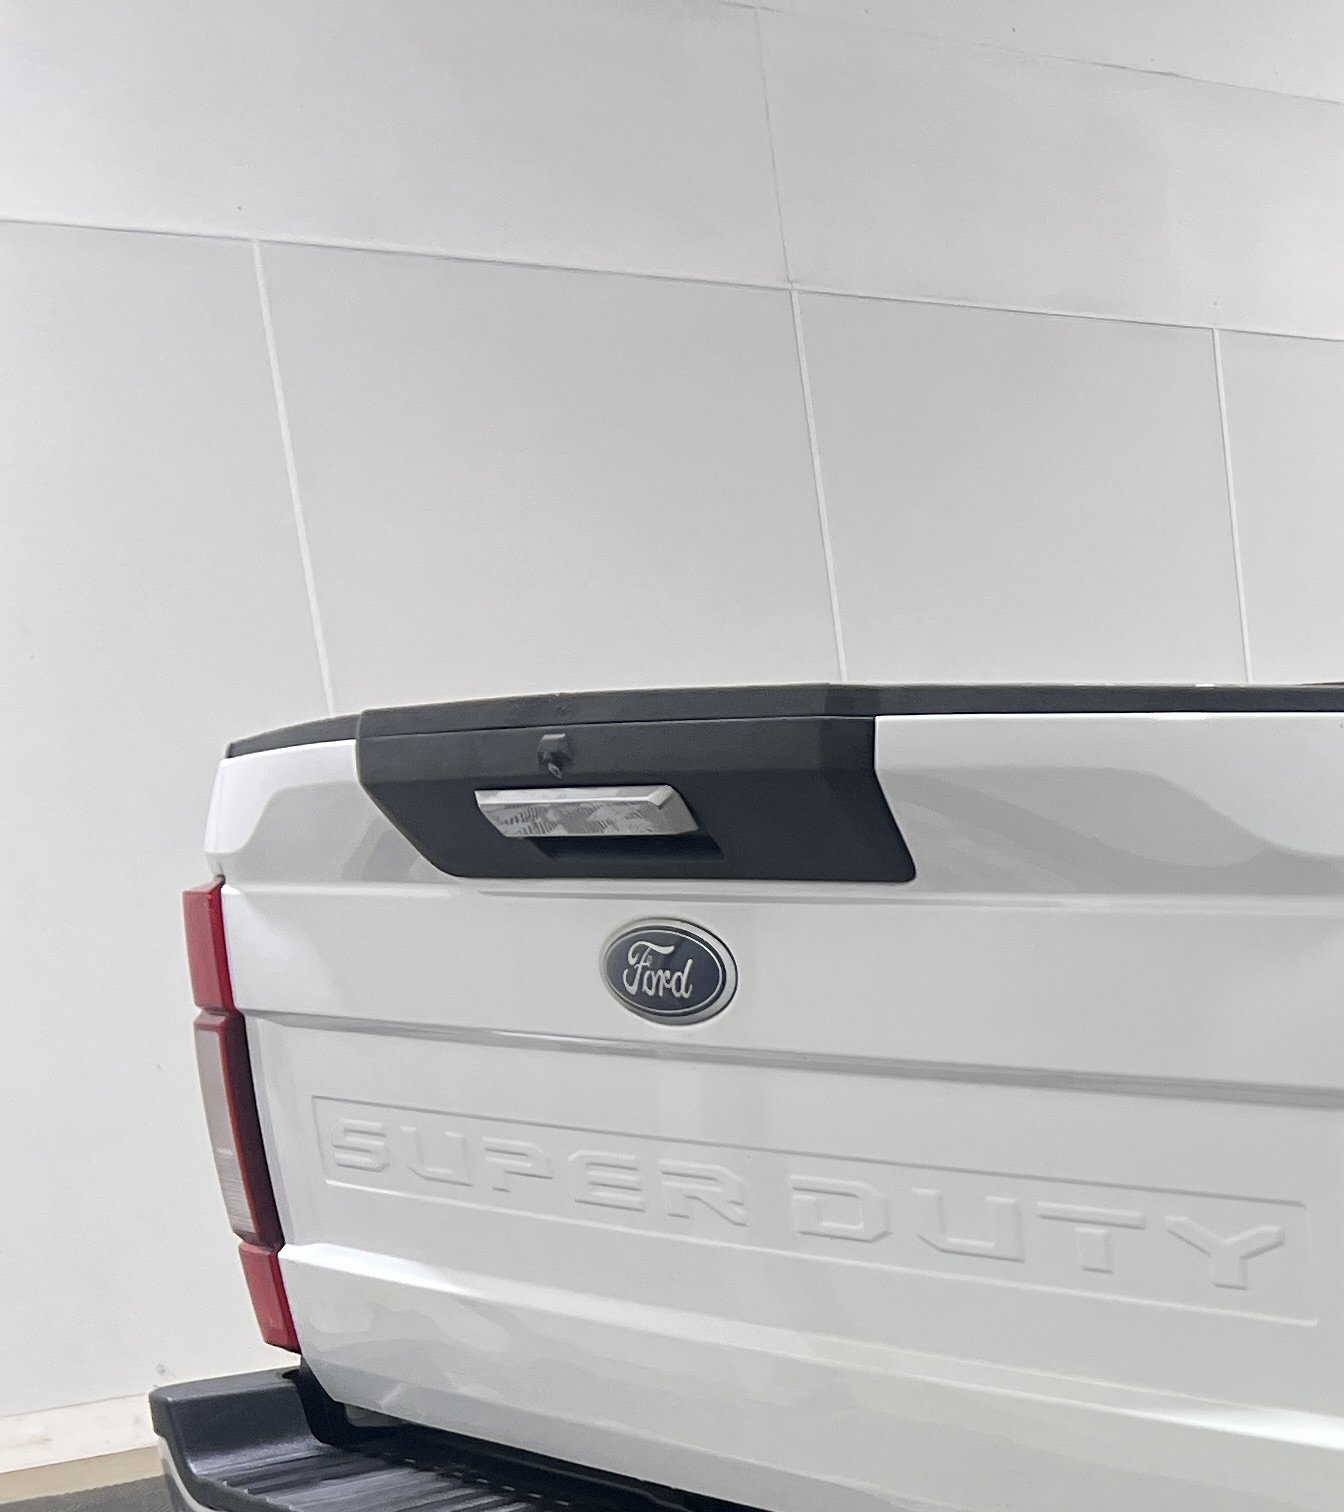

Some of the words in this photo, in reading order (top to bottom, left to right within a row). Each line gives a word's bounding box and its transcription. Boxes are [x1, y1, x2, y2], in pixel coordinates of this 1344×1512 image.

[622, 940, 694, 999] Ford
[331, 1116, 748, 1228] SUPER
[790, 1173, 1285, 1291] DUTY
